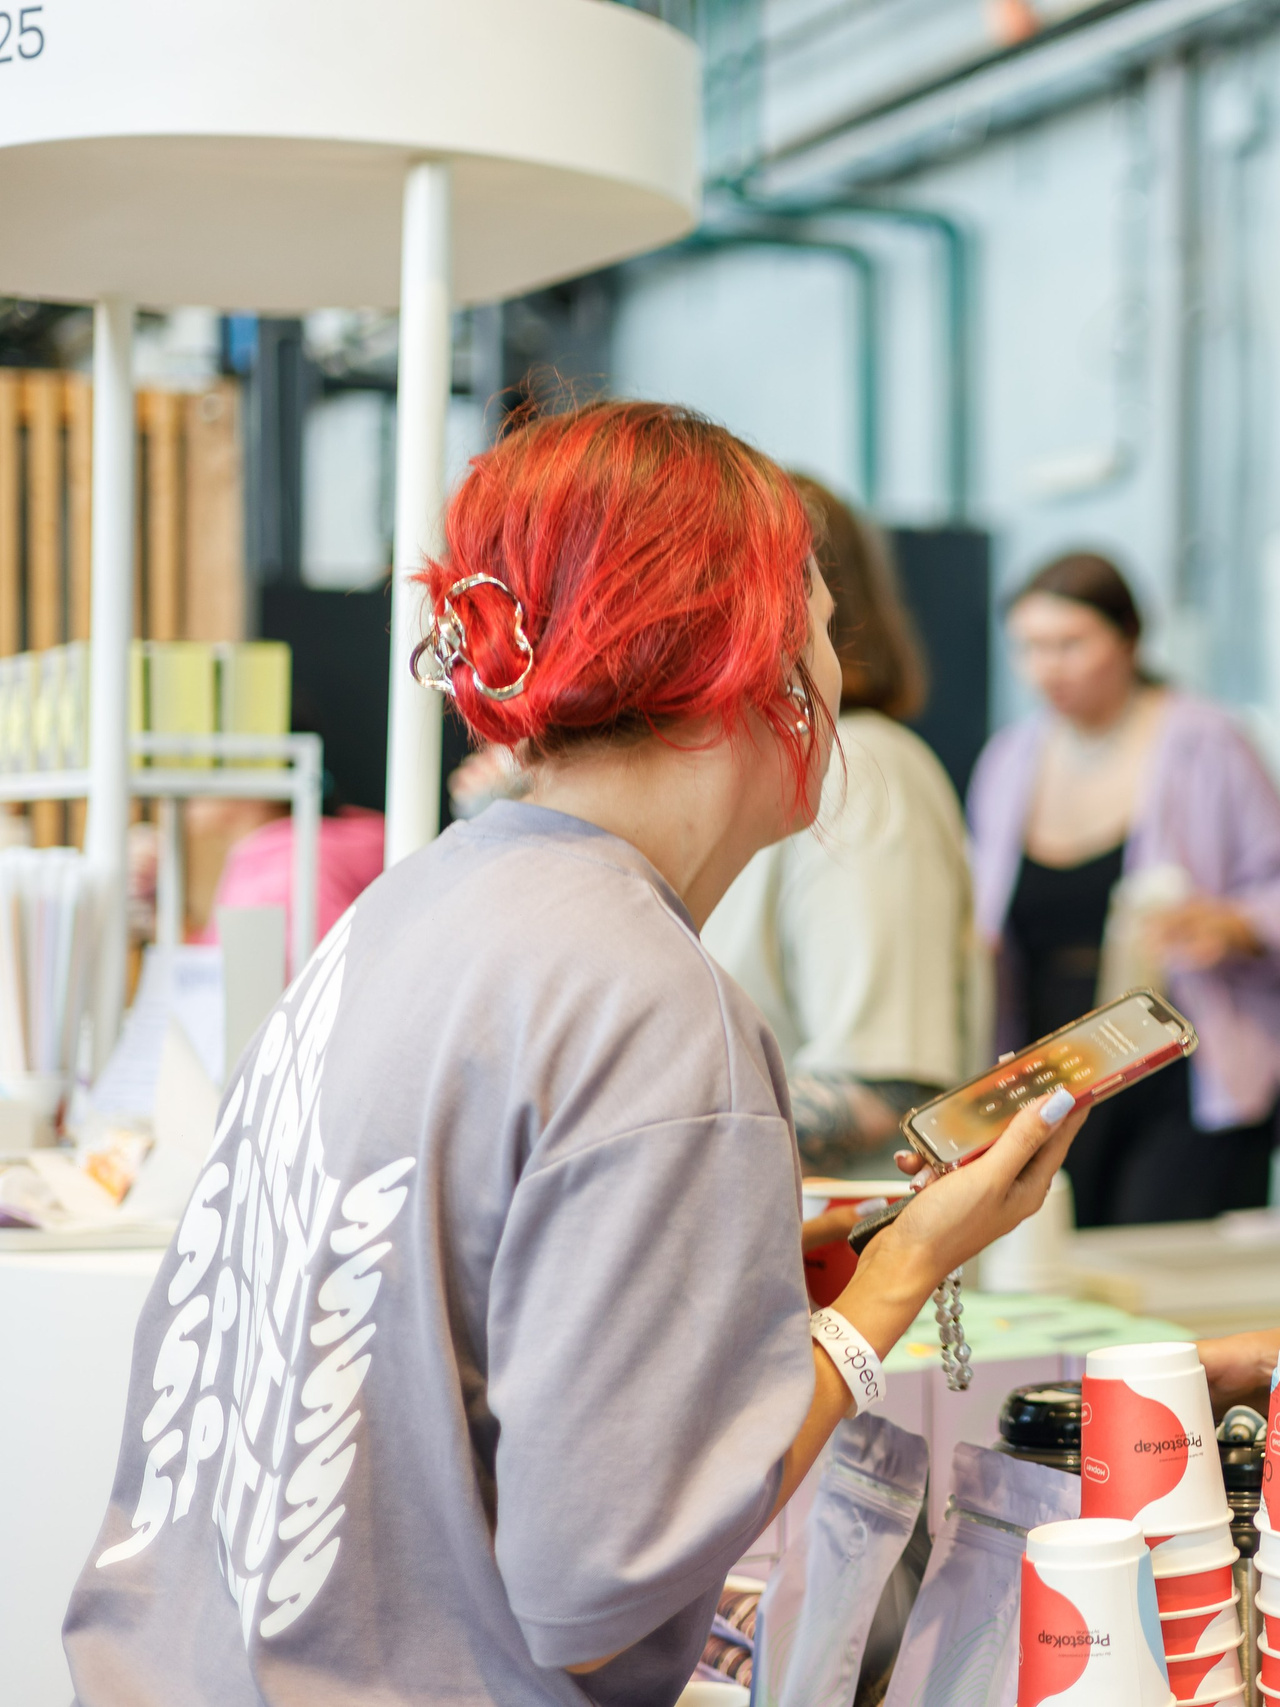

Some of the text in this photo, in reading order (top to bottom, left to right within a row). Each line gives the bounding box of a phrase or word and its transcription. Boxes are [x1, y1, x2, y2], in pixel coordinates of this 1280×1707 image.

[843, 1344, 880, 1403] фест
[1134, 1435, 1203, 1454] ProstoKap
[1086, 1464, 1106, 1477] маркет
[1038, 1630, 1111, 1648] ProstoKap
